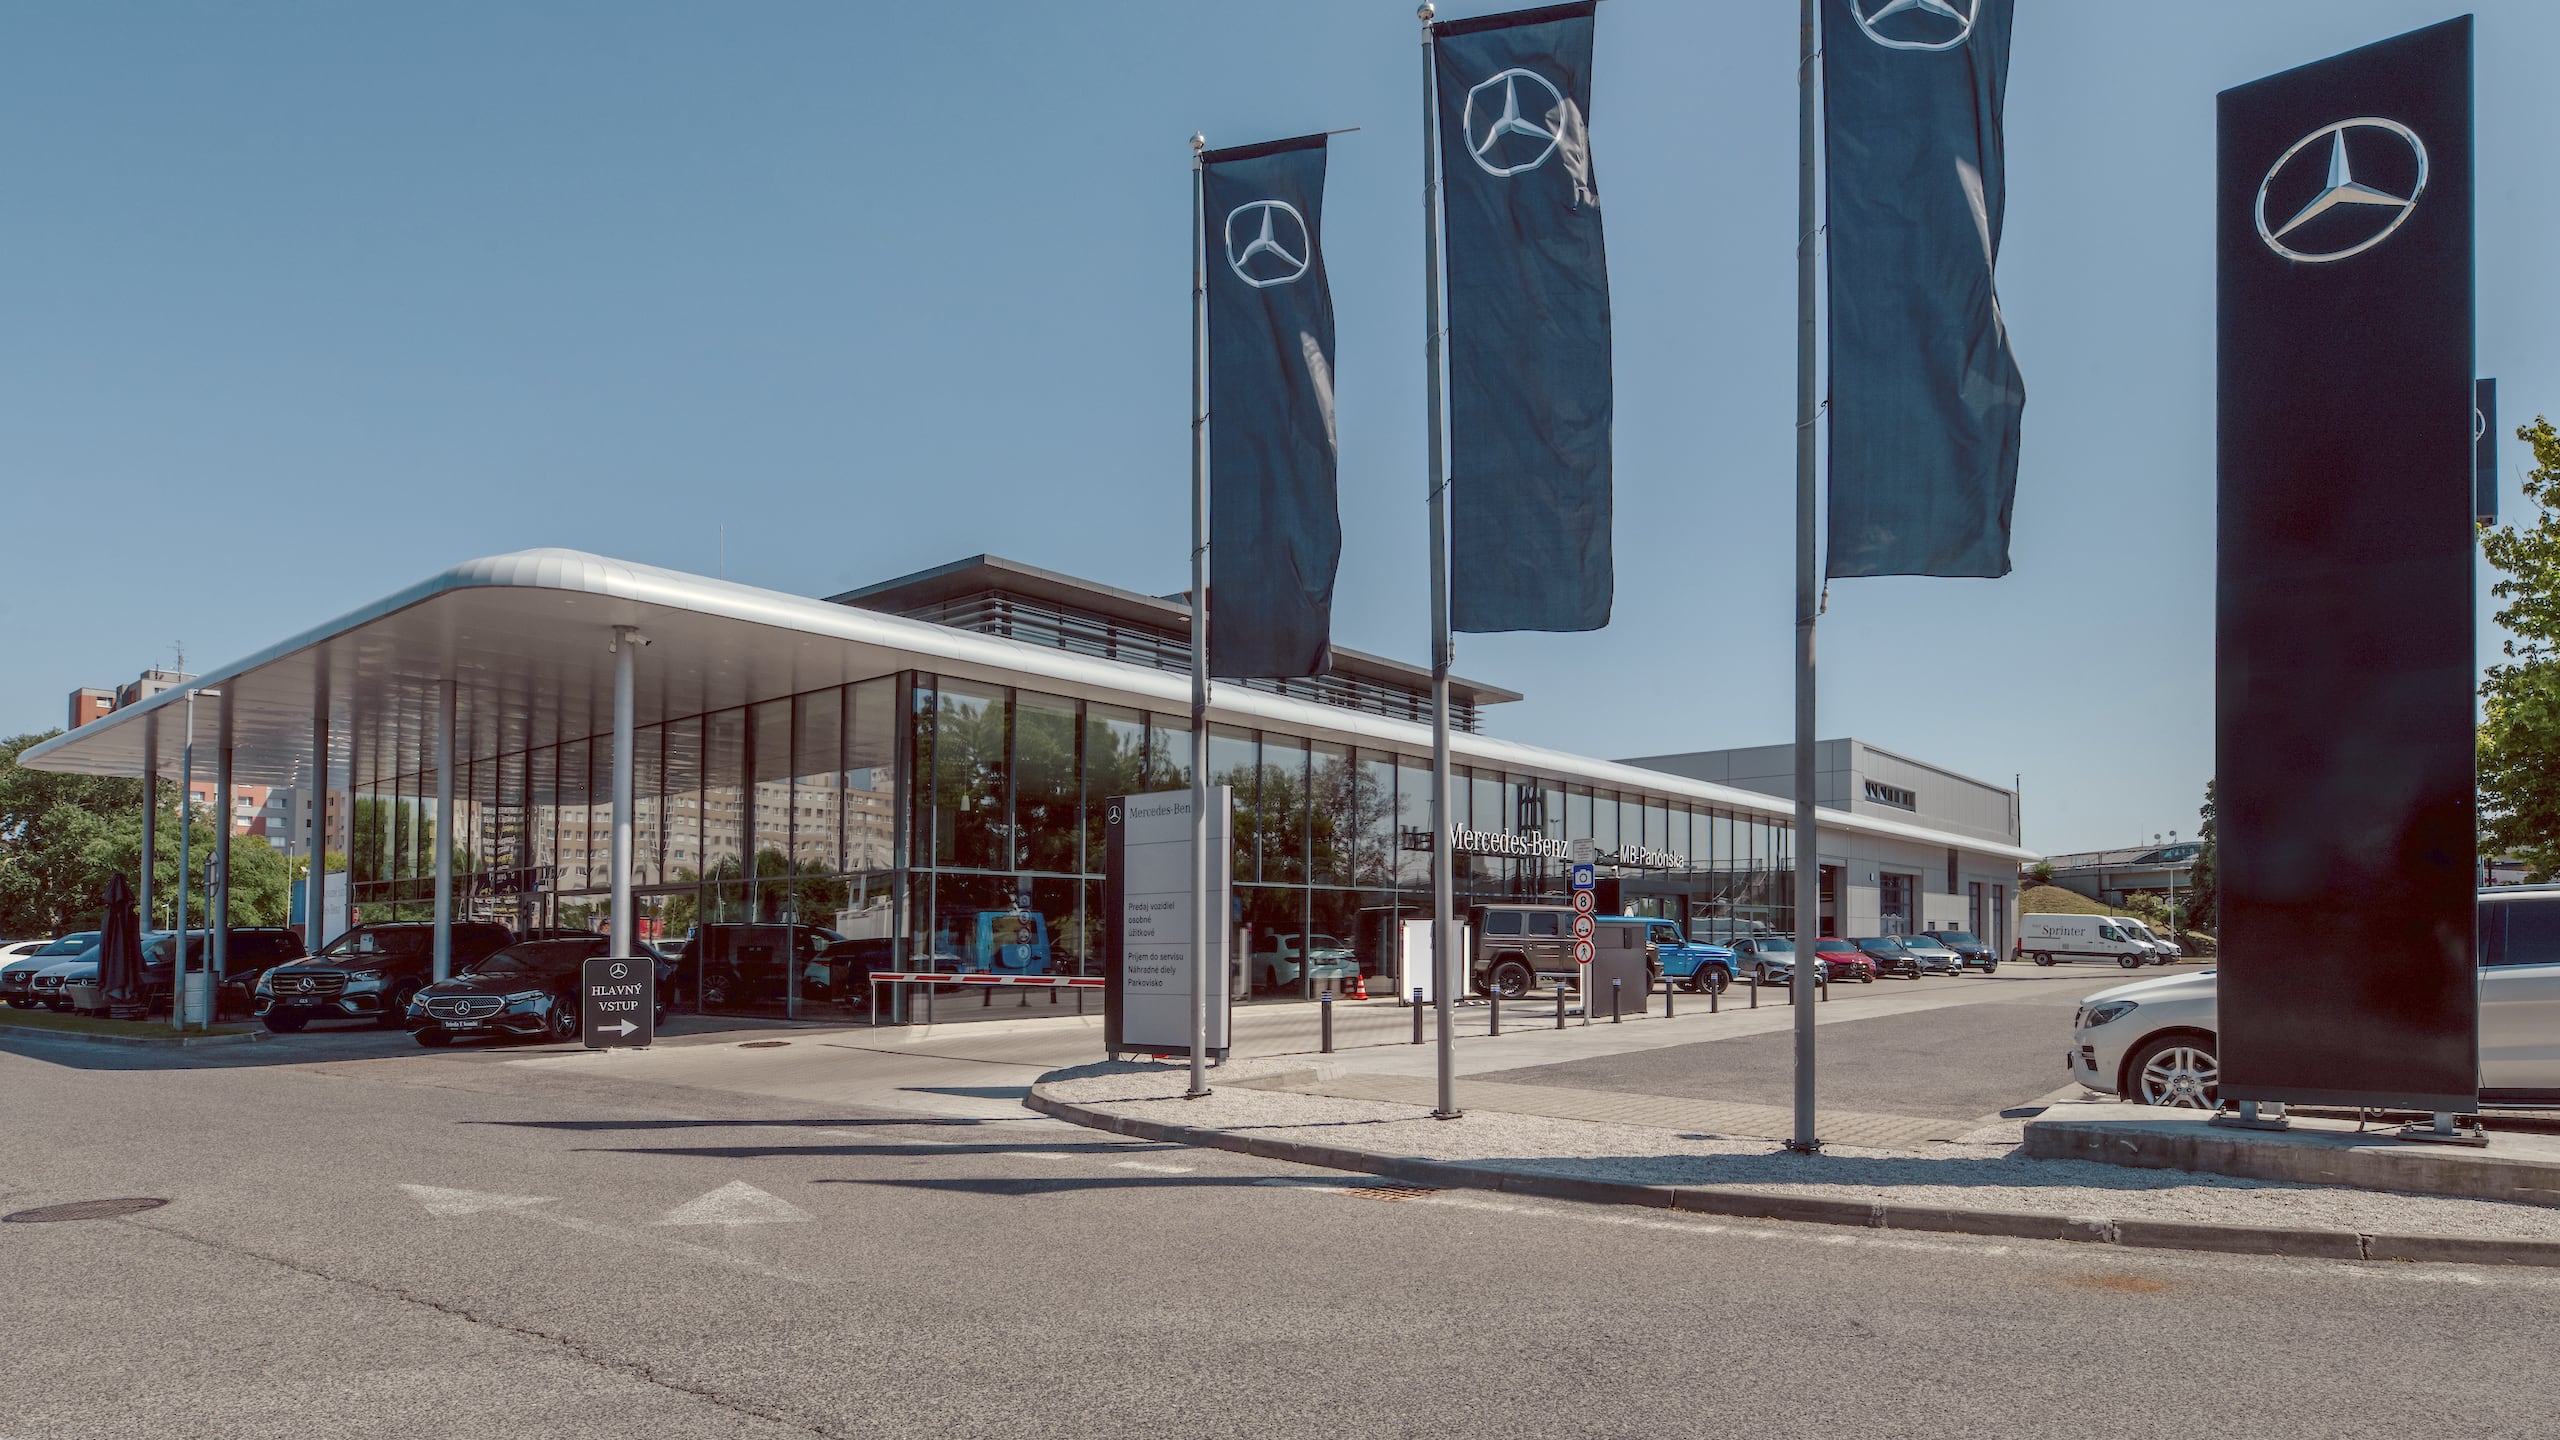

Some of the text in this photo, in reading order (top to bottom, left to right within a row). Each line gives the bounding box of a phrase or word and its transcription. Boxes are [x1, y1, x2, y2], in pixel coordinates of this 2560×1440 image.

[1129, 802, 1191, 819] Mercedes-Ben
[1449, 822, 1569, 859] Mercedes-Benz
[1620, 844, 1685, 868] MB-Panónska
[1128, 900, 1175, 913] Predaj vozidiel
[1580, 896, 1587, 908] 8
[1128, 914, 1152, 924] osobné
[1128, 927, 1155, 937] úžitkové
[2041, 924, 2086, 937] Sprinter
[1150, 952, 1159, 961] do
[1160, 952, 1184, 961] servisu
[1128, 965, 1177, 976] Náhradné diely
[1128, 978, 1164, 987] Parkovisko
[591, 982, 643, 997] HLAVNÝ
[598, 1000, 639, 1012] VSTUP
